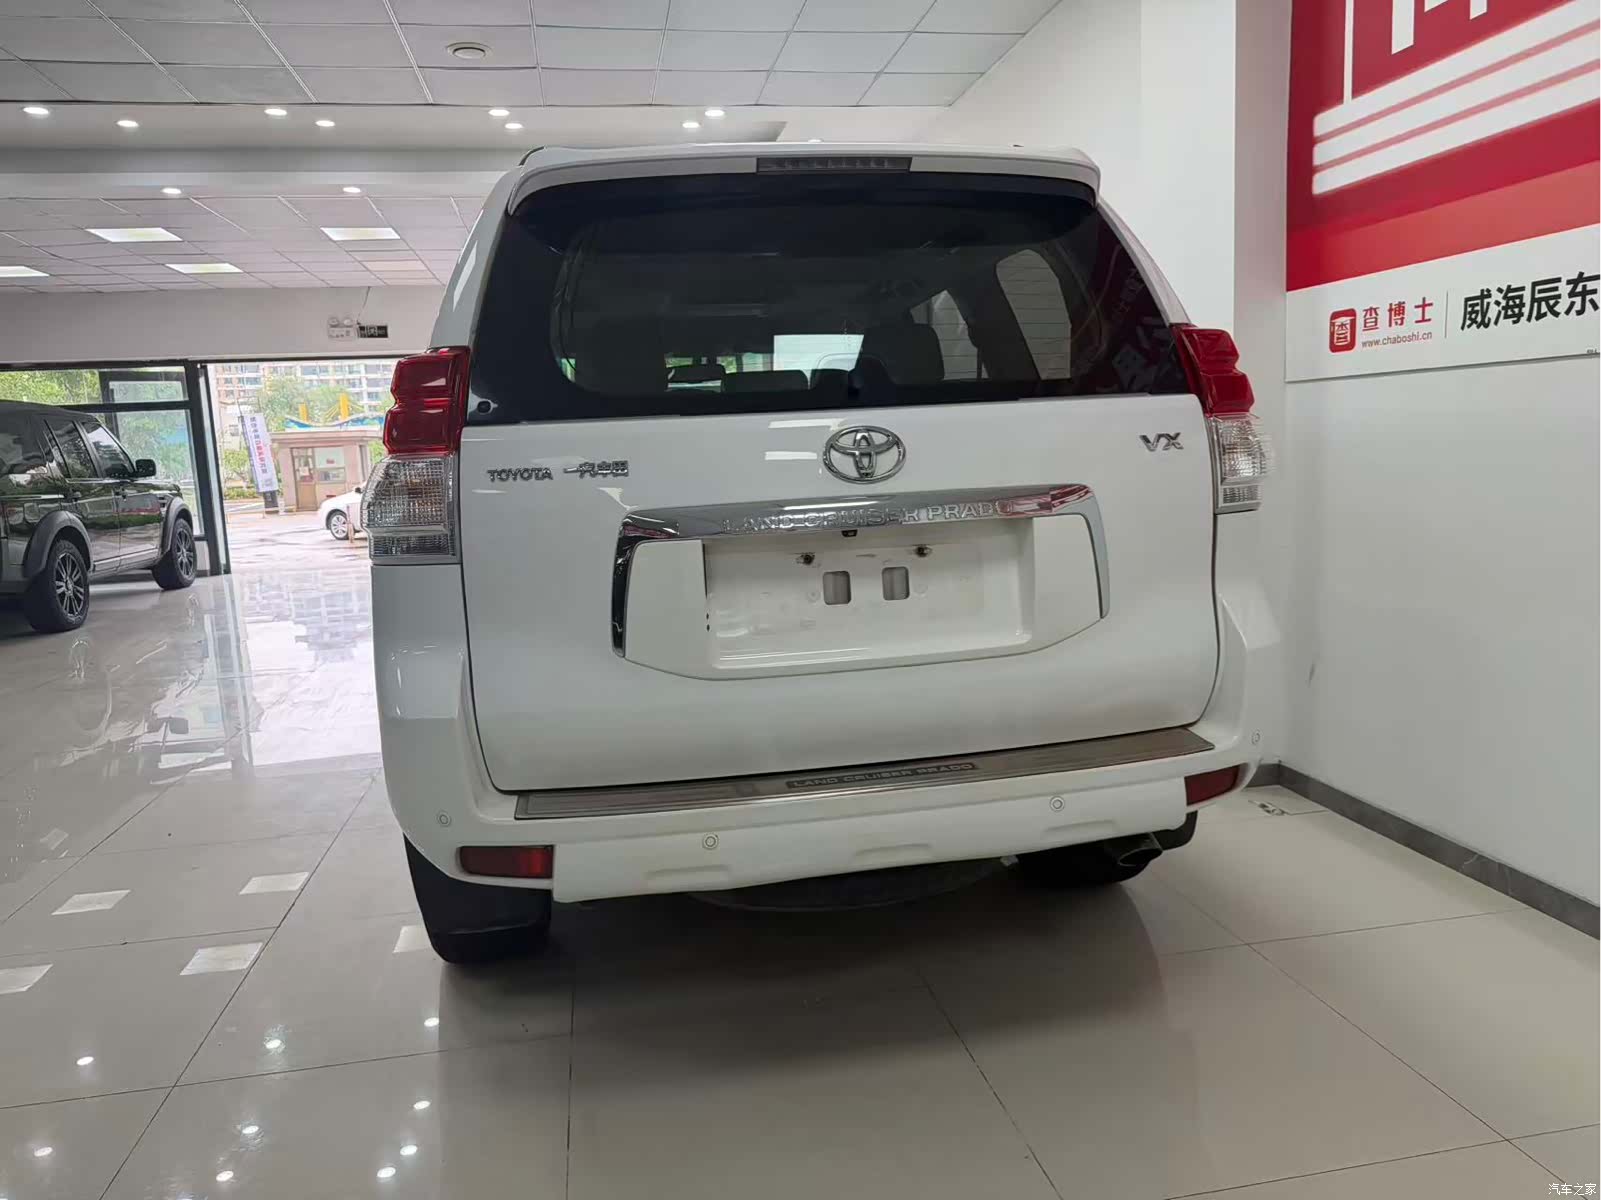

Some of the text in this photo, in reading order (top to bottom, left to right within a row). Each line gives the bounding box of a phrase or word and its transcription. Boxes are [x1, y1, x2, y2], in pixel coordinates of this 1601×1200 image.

[1460, 271, 1600, 331] 威海辰东
[1362, 296, 1434, 332] 查博士
[1361, 331, 1433, 349] www.chaboshi.cn
[1139, 432, 1184, 451] VX
[487, 467, 553, 482] TOYOTA
[927, 500, 1014, 520] PRADO
[792, 763, 973, 787] LAND CRUISER PRADO
